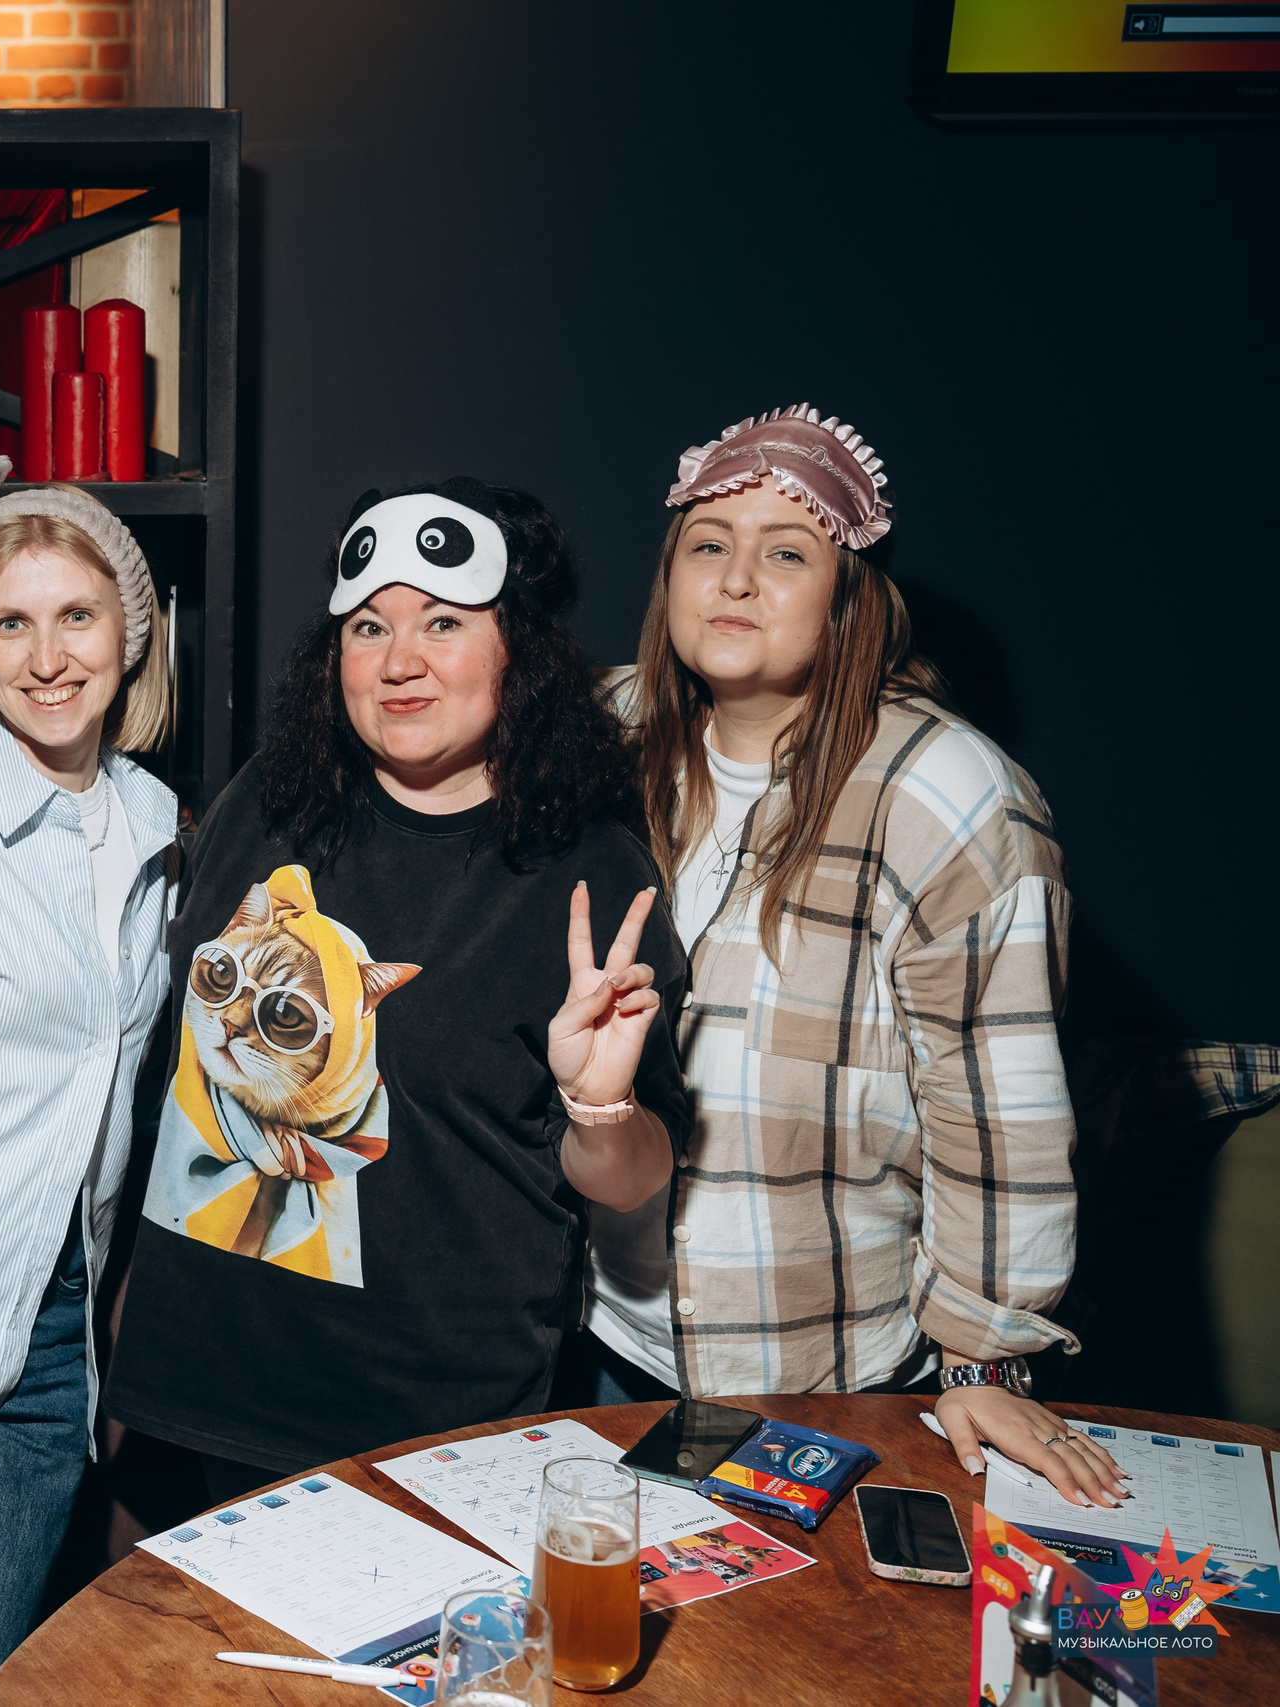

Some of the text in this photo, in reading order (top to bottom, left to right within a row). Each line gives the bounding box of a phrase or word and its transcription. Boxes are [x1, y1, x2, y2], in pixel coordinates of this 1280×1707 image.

[1236, 87, 1279, 96] TOSHIBA
[671, 1514, 718, 1530] Команда
[1206, 1542, 1257, 1554] Команда
[1074, 1552, 1113, 1565] ВАУ
[1234, 1552, 1258, 1560] Имя
[460, 1569, 494, 1586] Команда
[486, 1574, 503, 1584] Имя
[390, 1634, 440, 1661] УЗЫКАЛЬНОЕ
